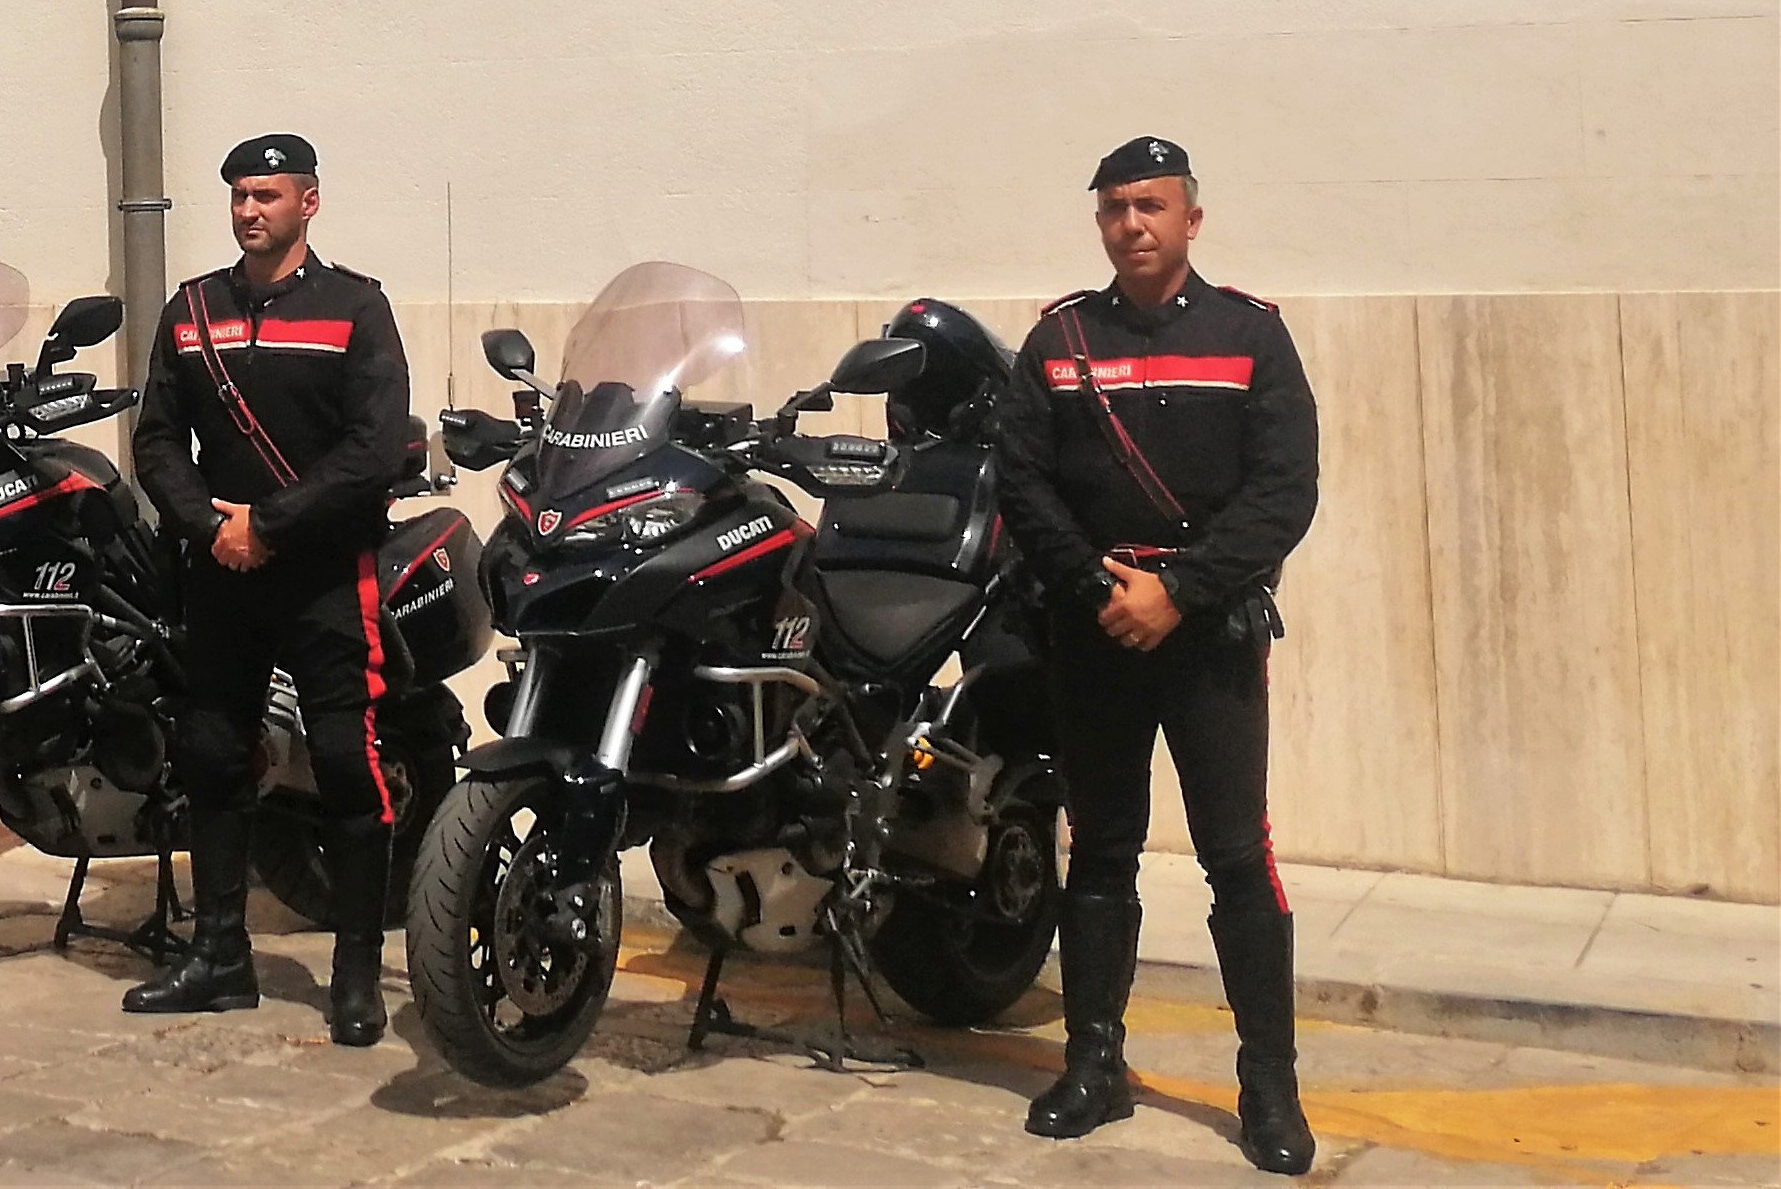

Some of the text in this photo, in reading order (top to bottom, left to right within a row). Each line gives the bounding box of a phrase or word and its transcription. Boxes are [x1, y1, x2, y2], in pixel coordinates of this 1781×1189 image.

[179, 324, 243, 342] CAINIERI
[1051, 364, 1132, 380] CARINIERI
[542, 423, 649, 448] CARABINIERI
[716, 515, 774, 551] DUCATI
[34, 561, 76, 591] 112
[771, 616, 812, 650] 112
